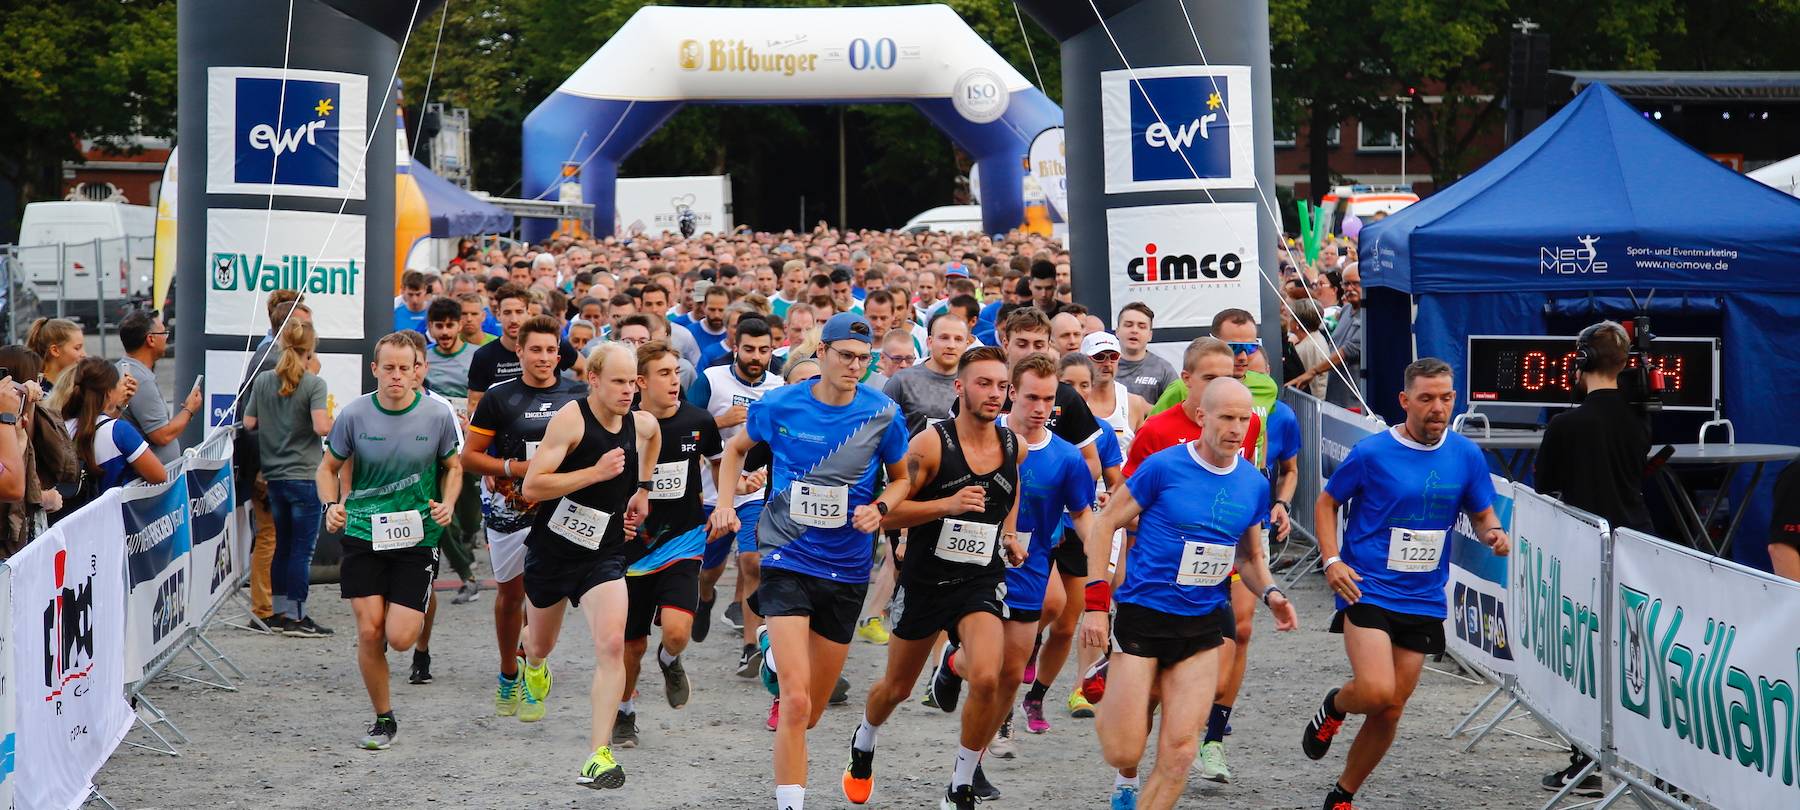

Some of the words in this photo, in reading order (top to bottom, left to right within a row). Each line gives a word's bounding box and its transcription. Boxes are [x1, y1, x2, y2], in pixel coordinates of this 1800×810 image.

[708, 39, 818, 76] Bitburger
[849, 37, 897, 71] 0.0
[967, 84, 996, 100] ISO
[249, 119, 326, 156] ewr
[1145, 113, 1217, 152] ewr
[1039, 160, 1066, 177] Bitb
[1541, 246, 1595, 260] Neo
[1626, 246, 1653, 257] Sport-
[1654, 246, 1671, 257] und
[1673, 247, 1738, 259] Eventmarketing
[1127, 243, 1242, 282] cimco
[1541, 260, 1608, 275] Move
[1635, 258, 1729, 271] www.neomove.de
[240, 253, 359, 295] Vaillant
[656, 477, 682, 490] 639
[801, 501, 840, 517] 1152
[385, 526, 411, 540] 100
[562, 515, 596, 538] 1325
[947, 537, 986, 554] 3082
[1401, 547, 1436, 561] 1222
[1192, 561, 1229, 575] 1217
[1529, 542, 1599, 700] Vaillant
[1648, 598, 1800, 790] Vaillan
